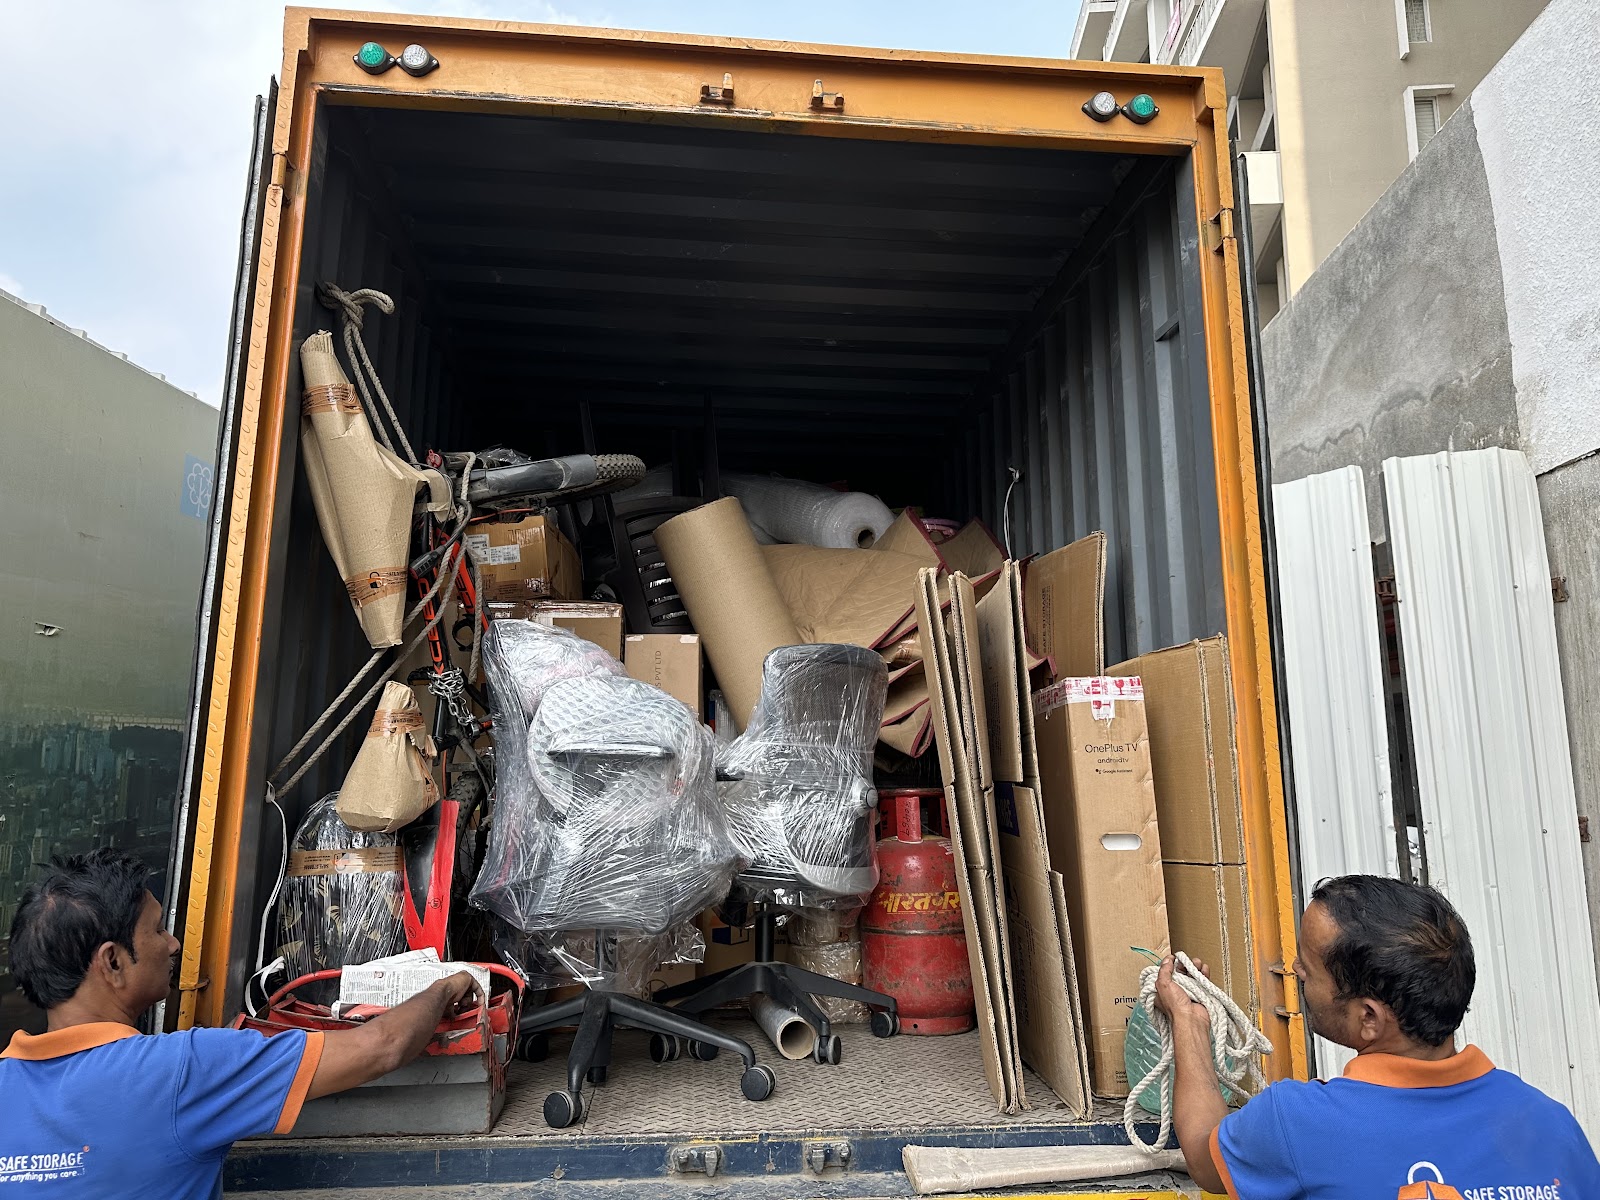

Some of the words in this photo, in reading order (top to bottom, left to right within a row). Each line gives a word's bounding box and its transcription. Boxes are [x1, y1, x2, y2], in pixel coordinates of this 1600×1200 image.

[1084, 744, 1124, 753] OnePlus
[1125, 743, 1138, 752] TV
[1114, 995, 1137, 1005] prime
[0, 1155, 28, 1171] SAFE
[31, 1152, 84, 1169] STORAGE
[11, 1172, 43, 1183] anything
[44, 1173, 58, 1181] you
[1464, 1187, 1495, 1200] SAFE
[1498, 1185, 1560, 1200] STORAGE
